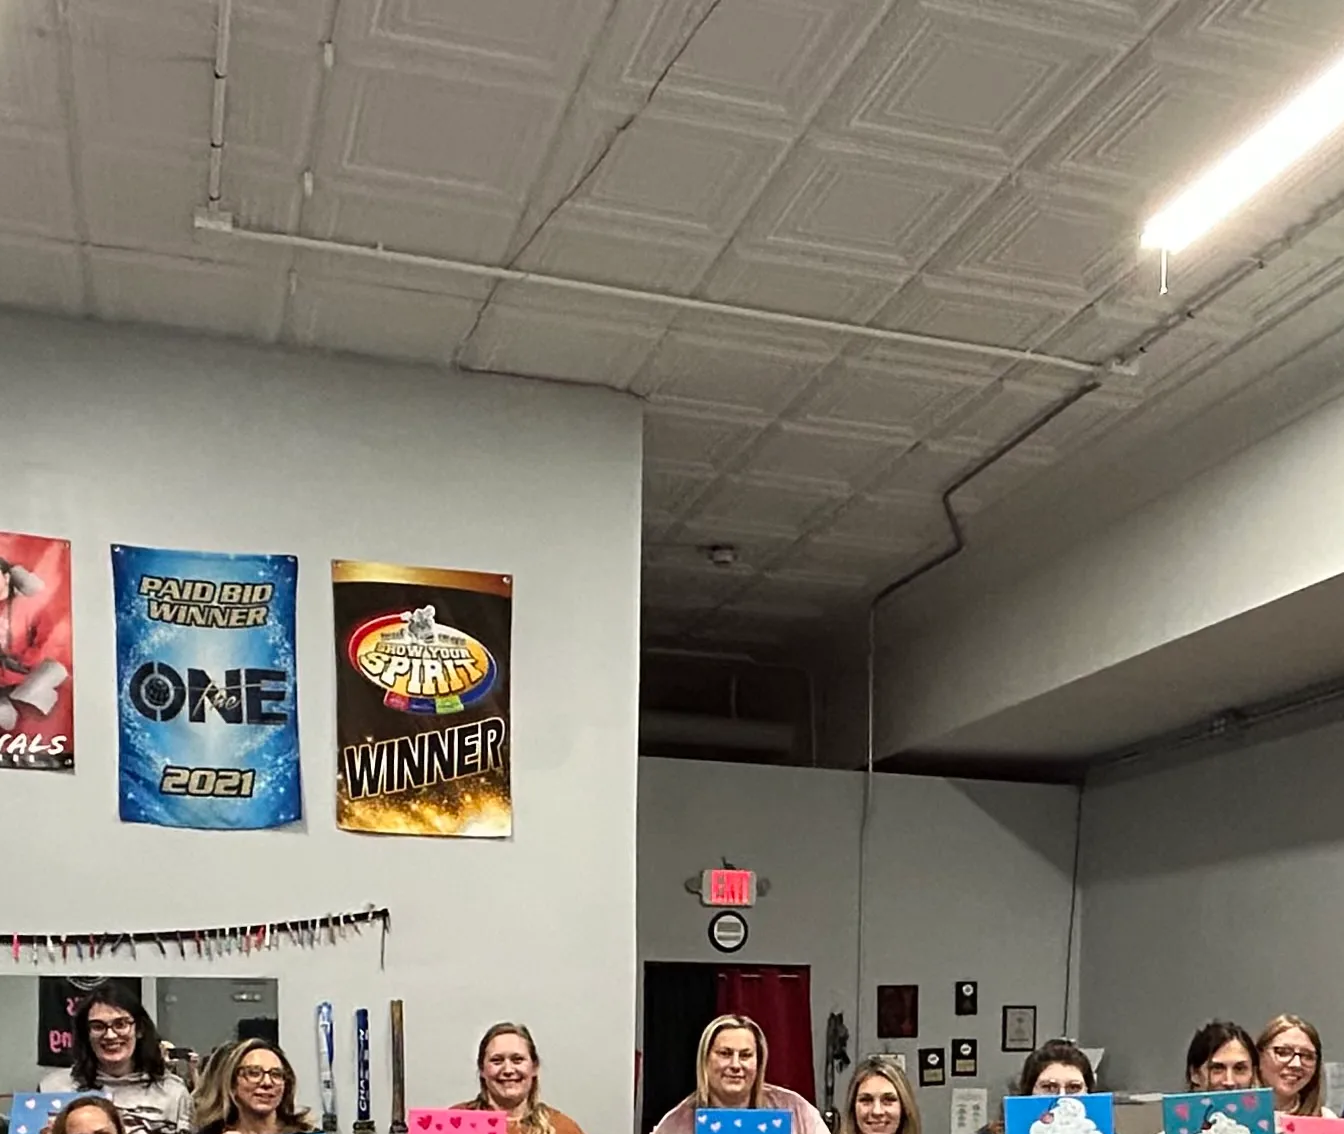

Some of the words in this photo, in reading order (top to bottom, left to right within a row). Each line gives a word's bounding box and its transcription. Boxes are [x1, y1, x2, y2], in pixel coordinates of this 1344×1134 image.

[140, 575, 216, 603] PAID
[219, 582, 274, 605] BID
[148, 601, 268, 628] WINNER
[375, 642, 425, 659] SHOW
[427, 646, 472, 661] YOUR
[358, 652, 483, 698] SPIRIT
[129, 661, 289, 725] ONE
[344, 716, 506, 801] WINNER
[160, 766, 256, 798] 2021
